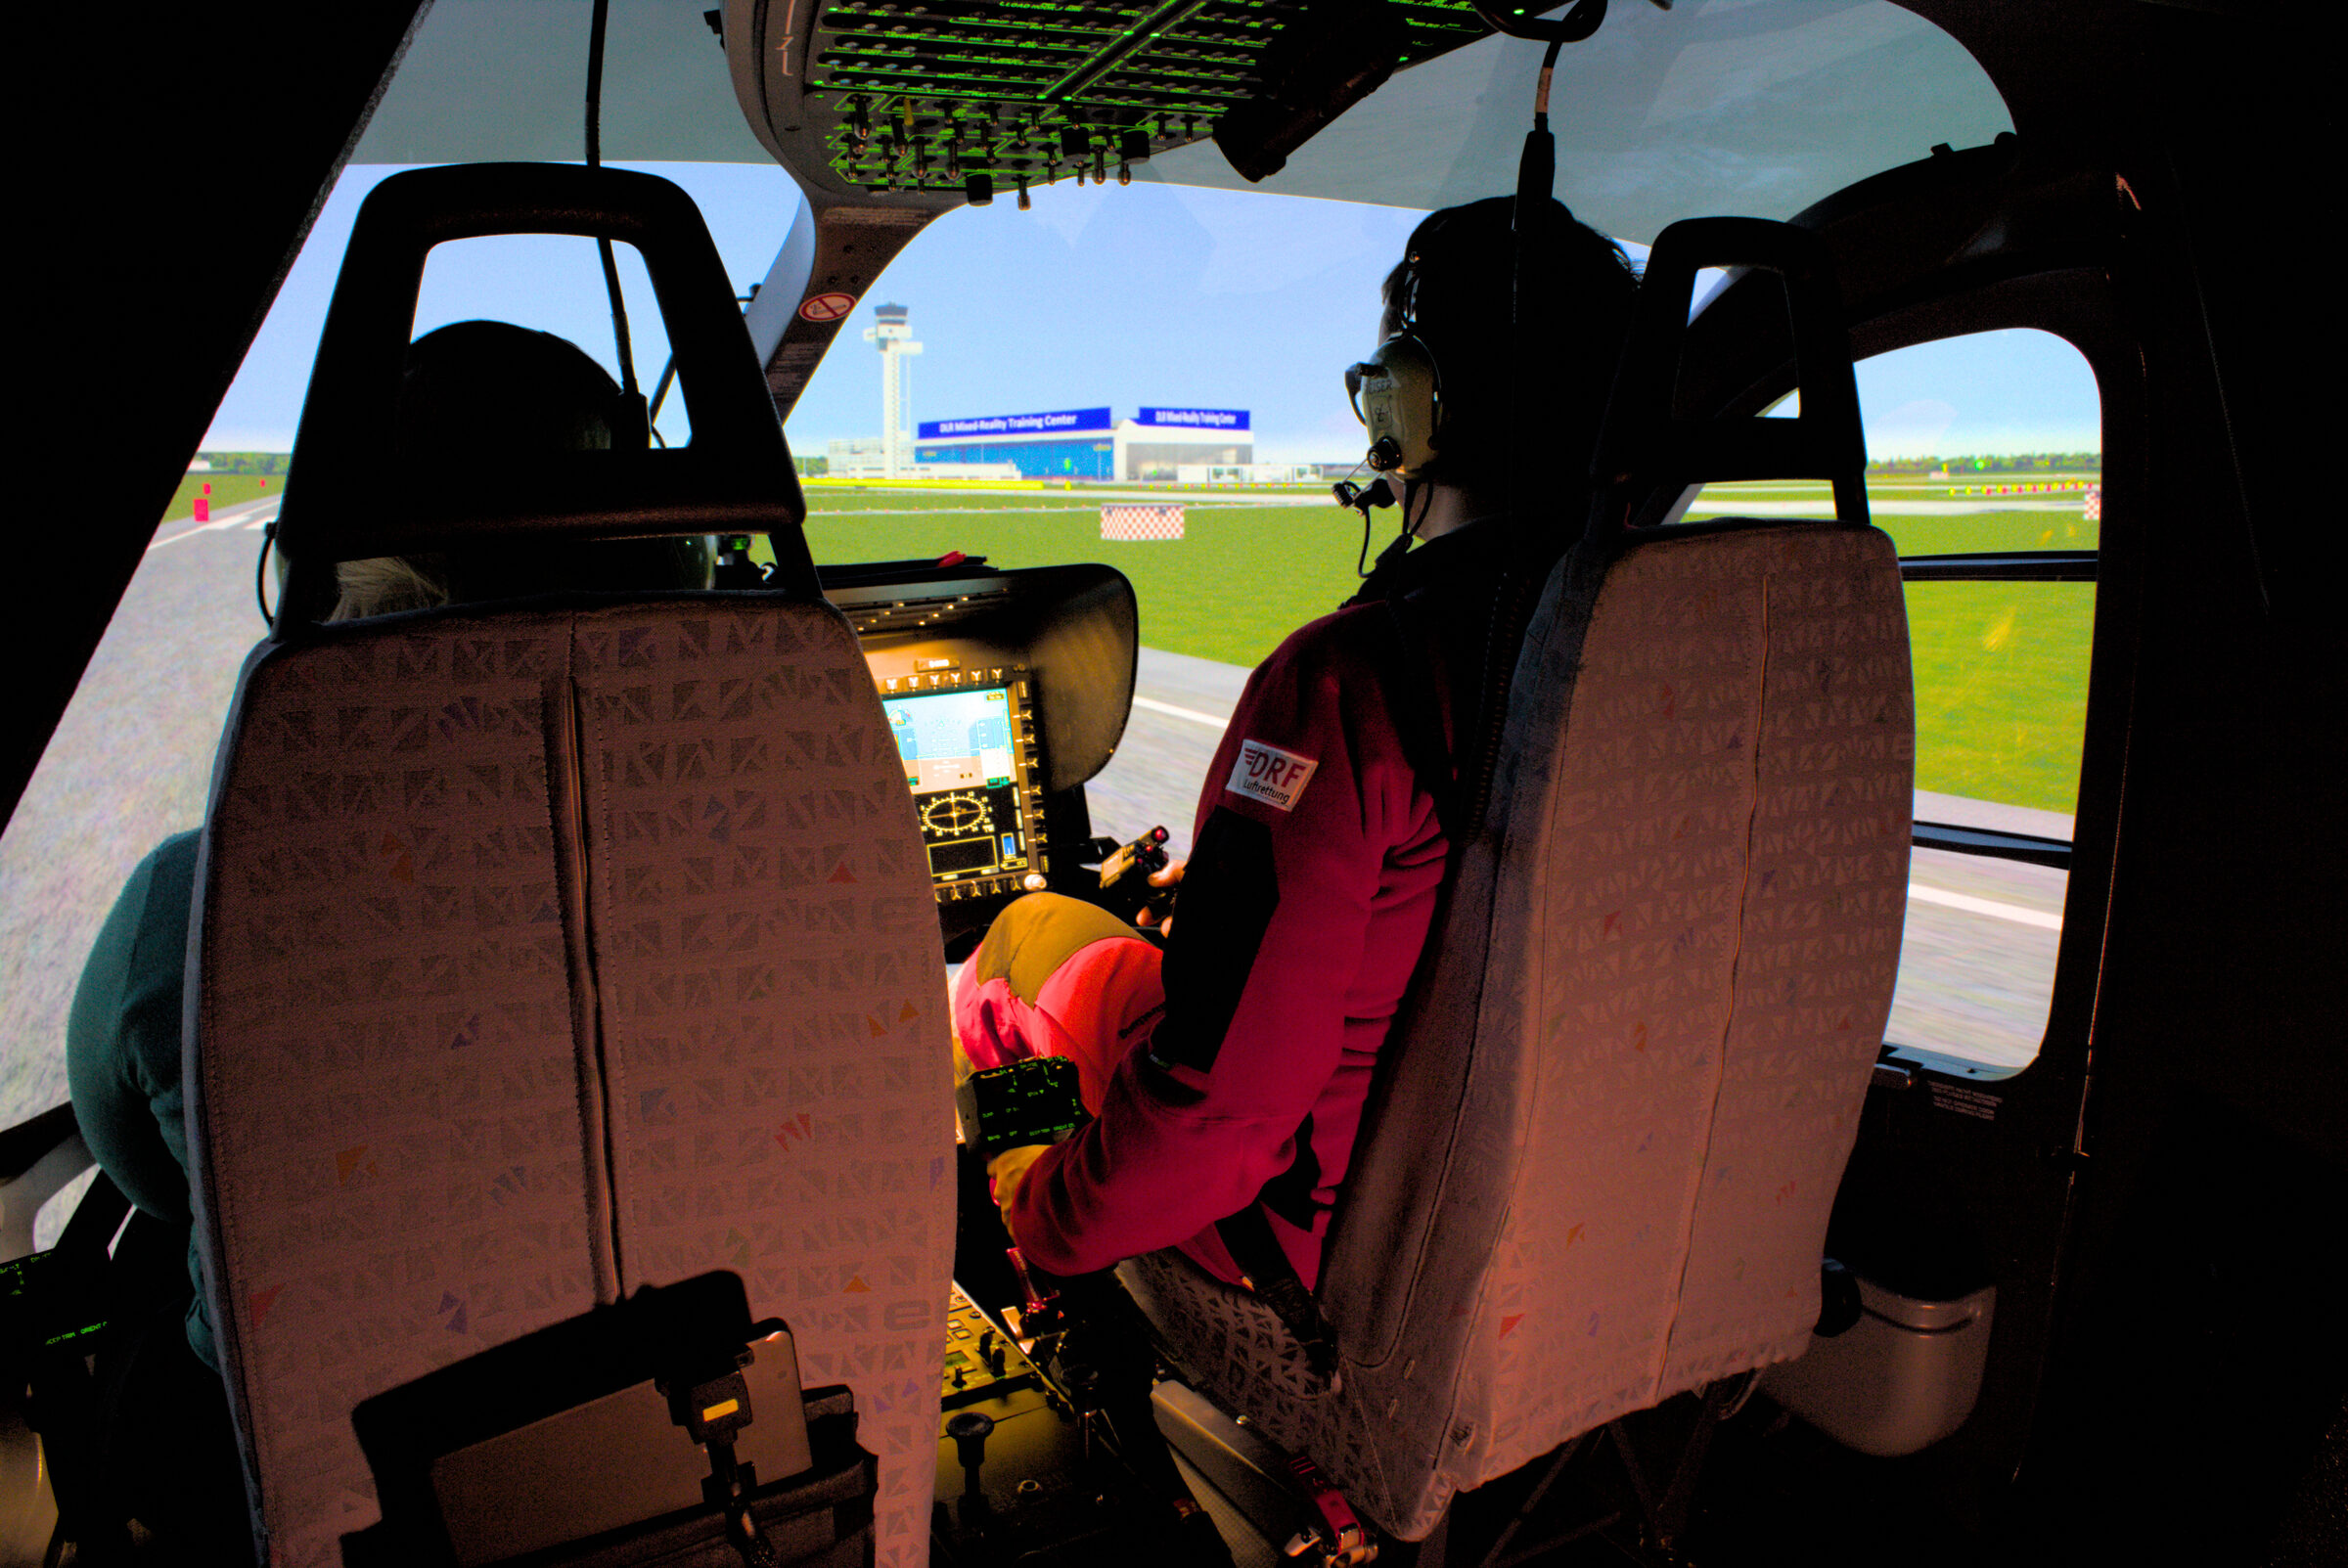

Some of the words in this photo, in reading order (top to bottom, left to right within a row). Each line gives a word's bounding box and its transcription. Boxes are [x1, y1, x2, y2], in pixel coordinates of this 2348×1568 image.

[940, 424, 954, 432] DLR
[955, 419, 1007, 431] Mixed-Reality
[1009, 416, 1043, 428] Training
[1044, 415, 1076, 426] Center
[1248, 751, 1306, 788] DRF
[1243, 779, 1290, 805] Luftrettung
